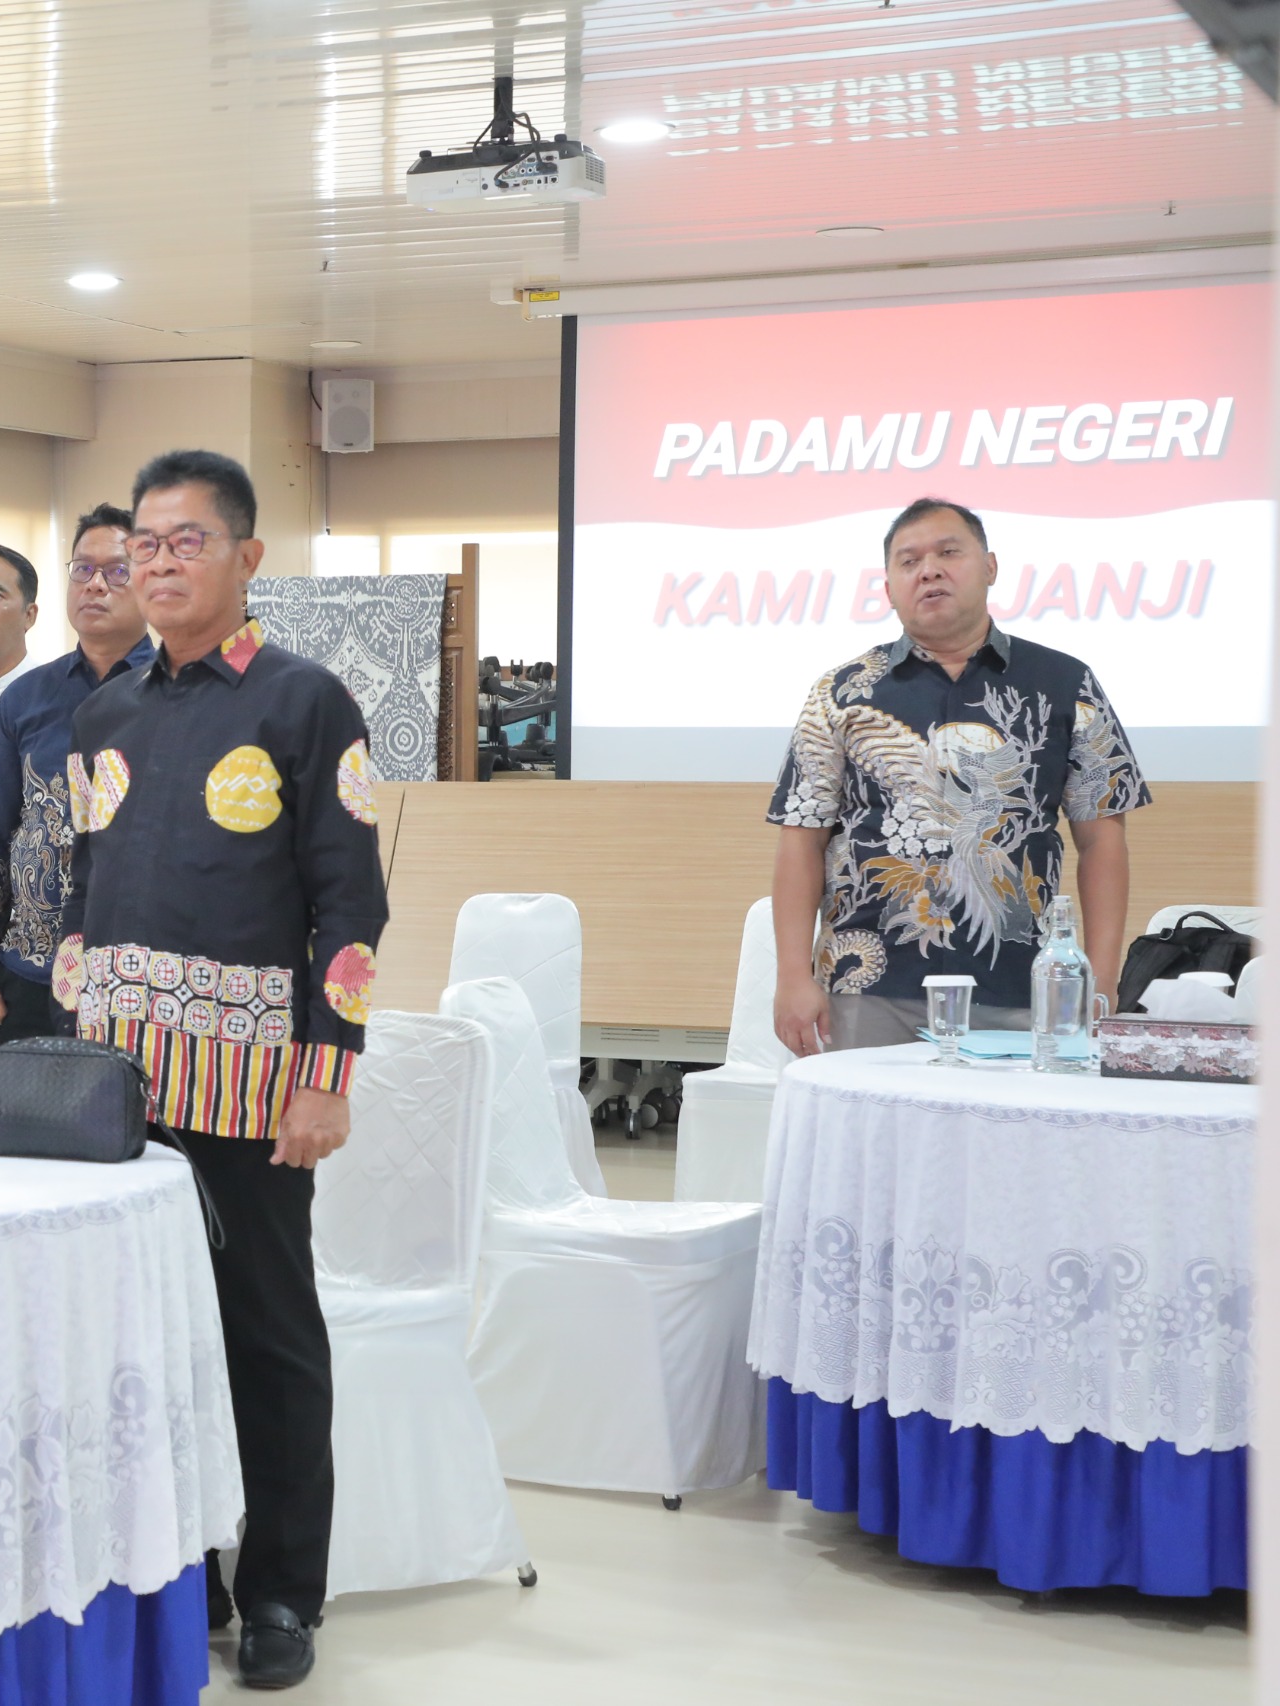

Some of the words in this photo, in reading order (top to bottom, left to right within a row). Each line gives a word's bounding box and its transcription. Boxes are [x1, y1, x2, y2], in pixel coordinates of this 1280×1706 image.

[653, 411, 950, 479] PADAMU
[960, 396, 1234, 468] NEGERI
[653, 570, 834, 627] KAMI
[849, 558, 1214, 624] BJANJI
